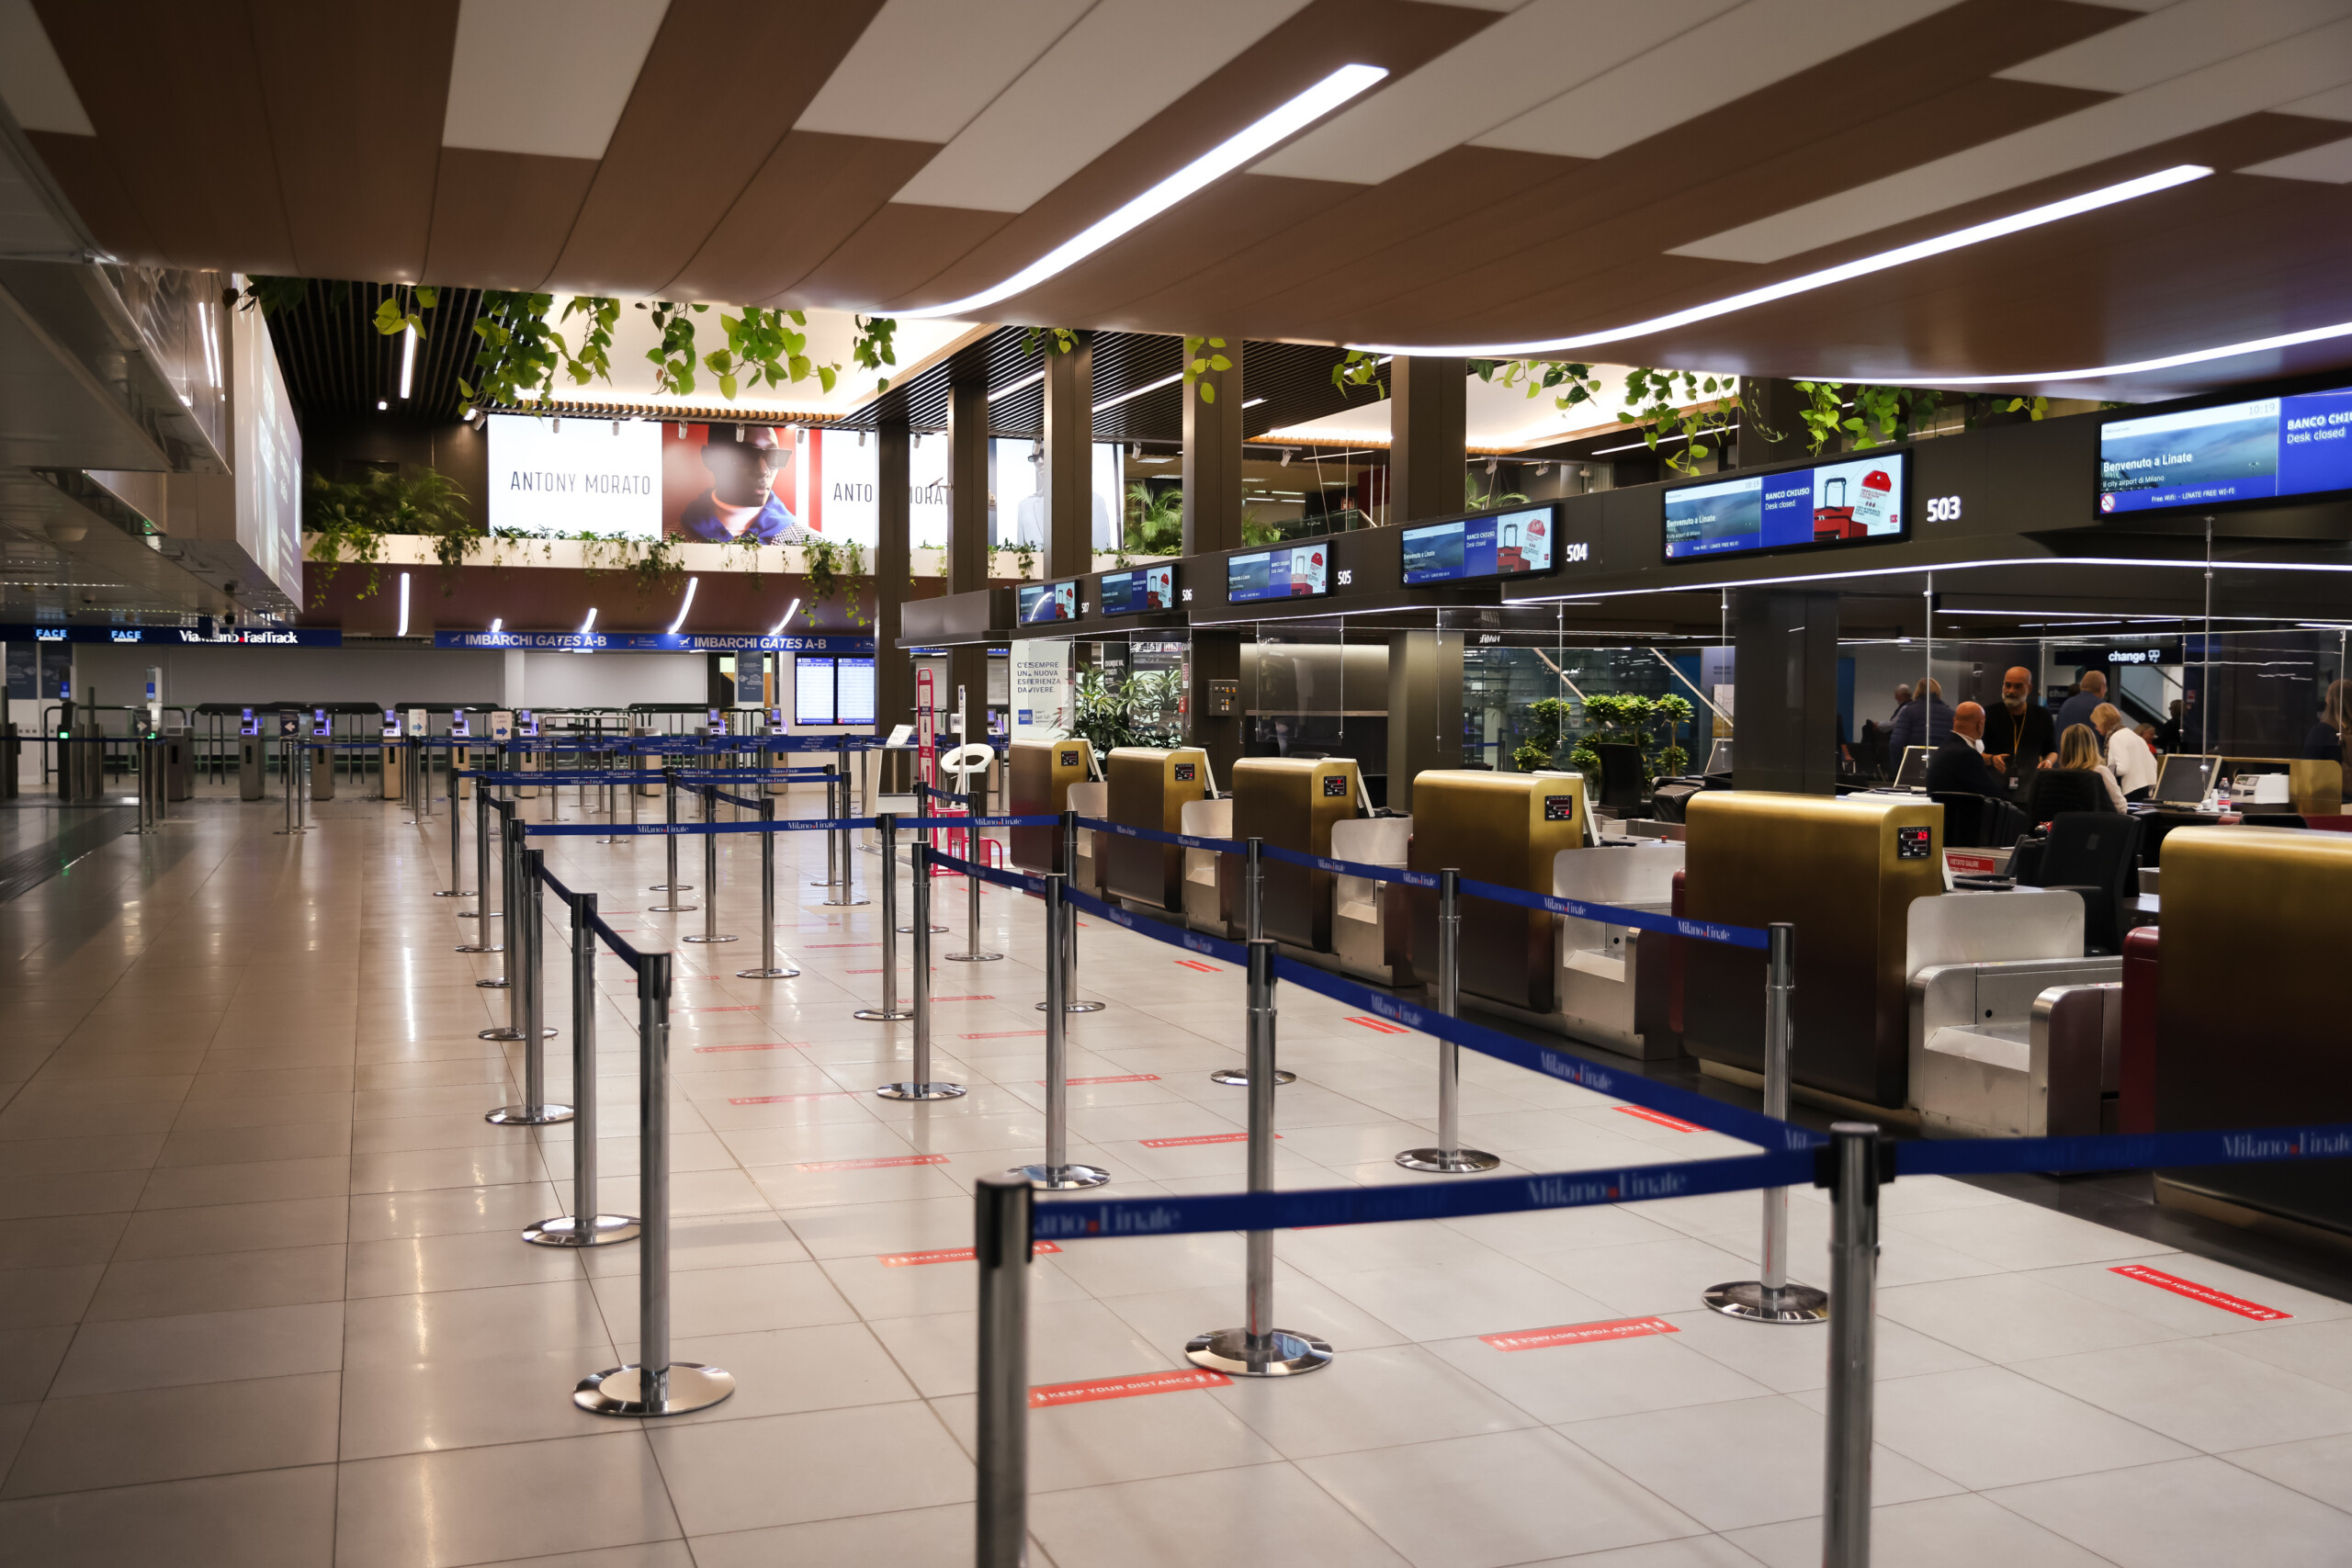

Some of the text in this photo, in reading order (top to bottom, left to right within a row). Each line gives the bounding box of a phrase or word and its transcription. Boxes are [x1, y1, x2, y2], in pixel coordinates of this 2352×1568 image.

[2250, 403, 2276, 415] 10:19
[2287, 415, 2325, 430] BANCO
[2287, 426, 2345, 444] Desk closed
[2103, 452, 2192, 473] Benvenuto a Linate
[510, 471, 650, 495] ANTONY MORATO
[2108, 479, 2117, 488] city
[2119, 477, 2137, 488] airport
[2138, 476, 2143, 484] di
[2145, 474, 2164, 484] Milano
[833, 482, 948, 505] ANTO ORA
[1765, 488, 1810, 500] BANCO CHIUSO
[2182, 491, 2202, 500] LINATE
[2218, 487, 2235, 496] WI-FI
[1779, 500, 1796, 508] closed
[1926, 496, 1962, 523] 503
[1667, 517, 1694, 528] Benvenuto
[1699, 514, 1716, 524] Linate
[1481, 530, 1496, 539] CHIUSO
[1476, 539, 1487, 547] closed
[1566, 543, 1589, 562] 504
[1337, 570, 1352, 585] 505
[1182, 589, 1193, 601] 506
[1081, 602, 1090, 614] 507
[36, 629, 67, 638] FACE
[111, 630, 141, 639] FACE
[465, 634, 607, 647] IMBARCHI GATES A-B
[694, 637, 827, 649] IMBARCHI GATES A-B
[2108, 650, 2146, 663] change
[2171, 1282, 2200, 1294] YOUR
[2199, 1292, 2254, 1311] DISTANCE
[1577, 1328, 1611, 1337] YOUR
[1048, 1376, 1193, 1399] KEEP YOUR DISTANCE
